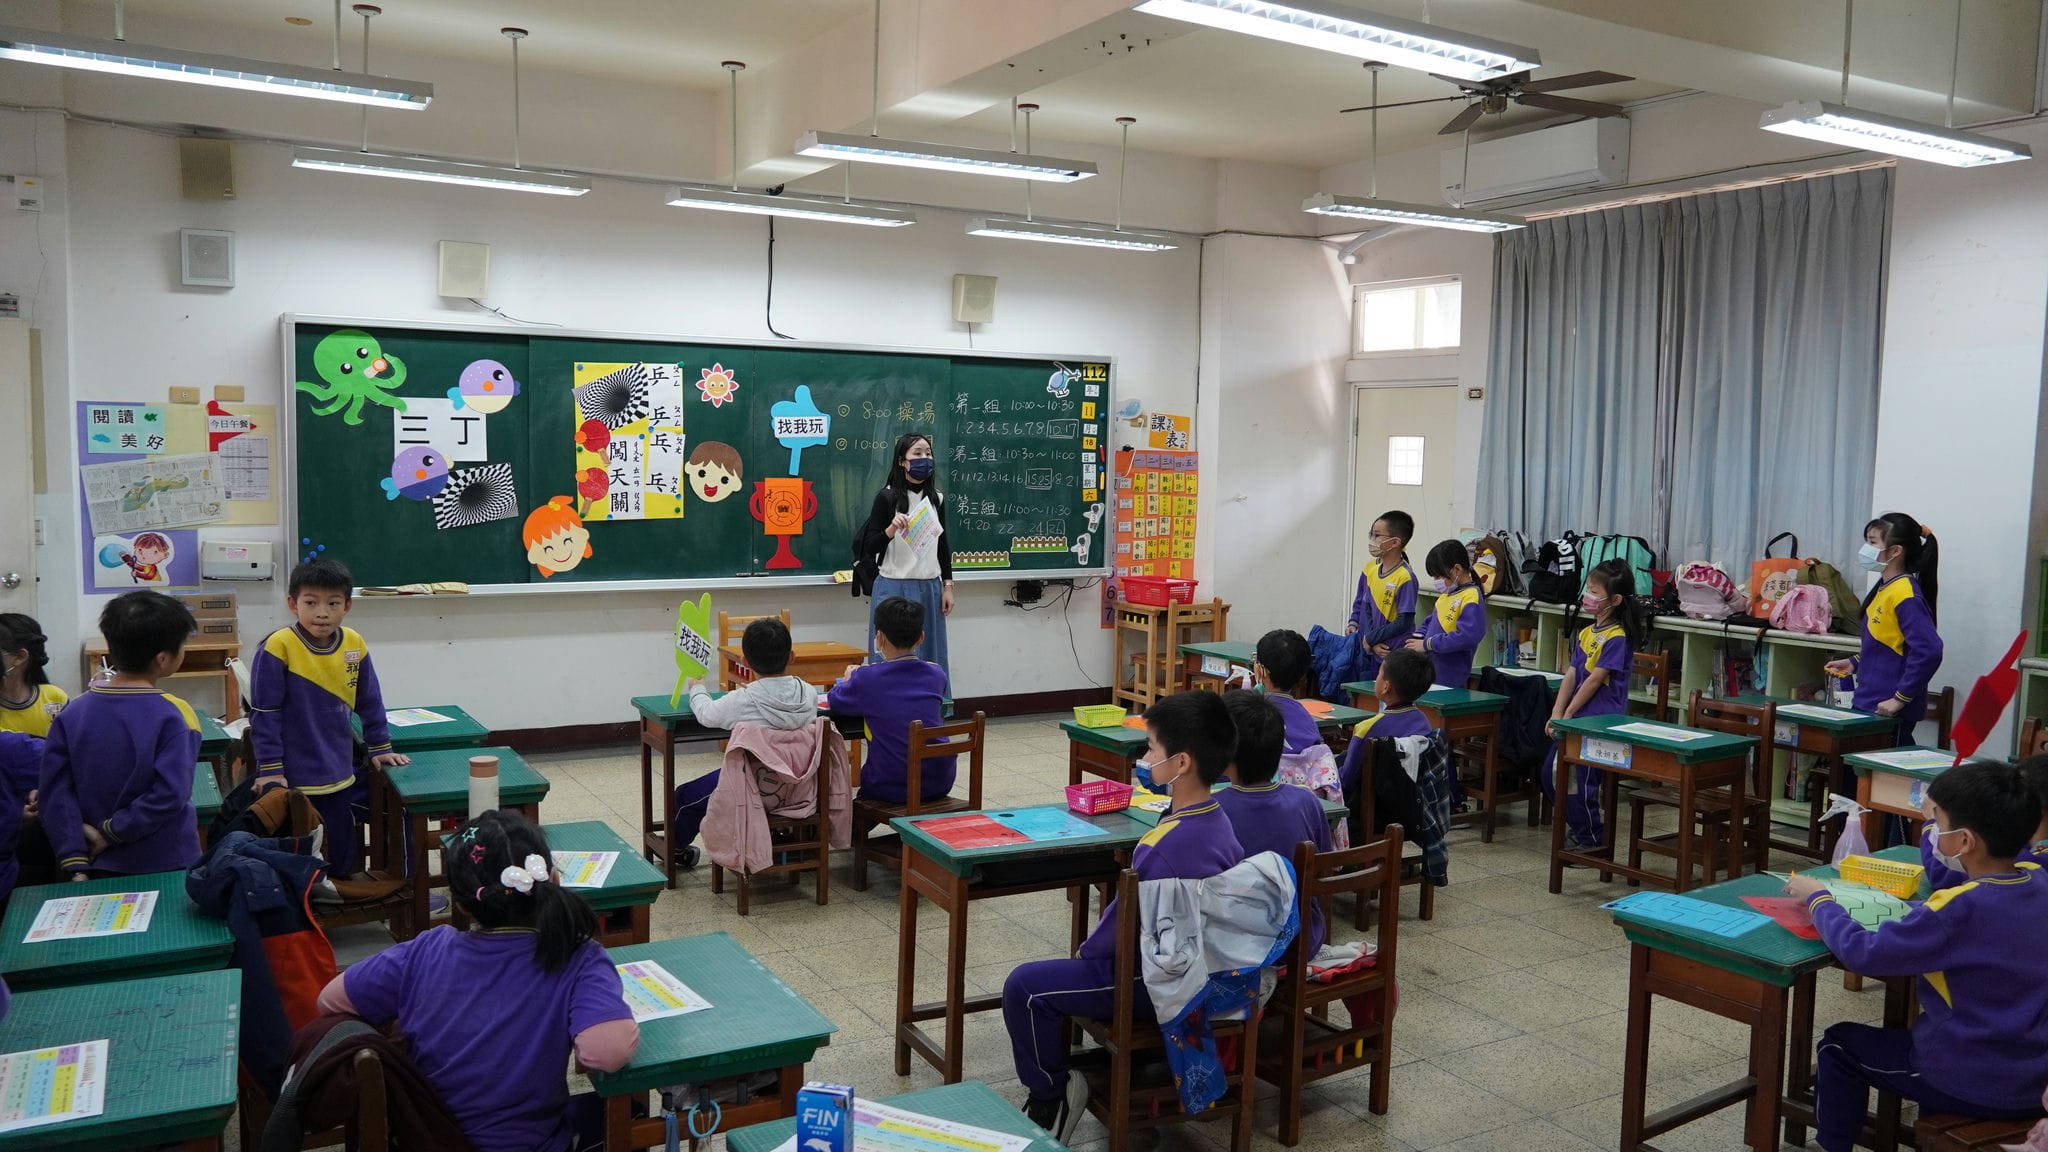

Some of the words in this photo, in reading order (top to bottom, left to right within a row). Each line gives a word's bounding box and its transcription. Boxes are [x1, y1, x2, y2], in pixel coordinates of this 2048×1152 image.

[1083, 366, 1106, 379] 112
[93, 409, 134, 424] 閱讀
[896, 402, 936, 424] 操場
[210, 418, 249, 429] 今日午餐
[778, 418, 823, 434] 找我玩
[121, 433, 164, 450] 美好
[854, 440, 888, 449] 10:00
[609, 440, 630, 512] 闖天關
[1085, 491, 1094, 500] 六
[1107, 586, 1116, 599] 6
[1105, 607, 1113, 621] 7
[680, 625, 711, 666] 找我玩
[802, 1107, 839, 1128] FIN
